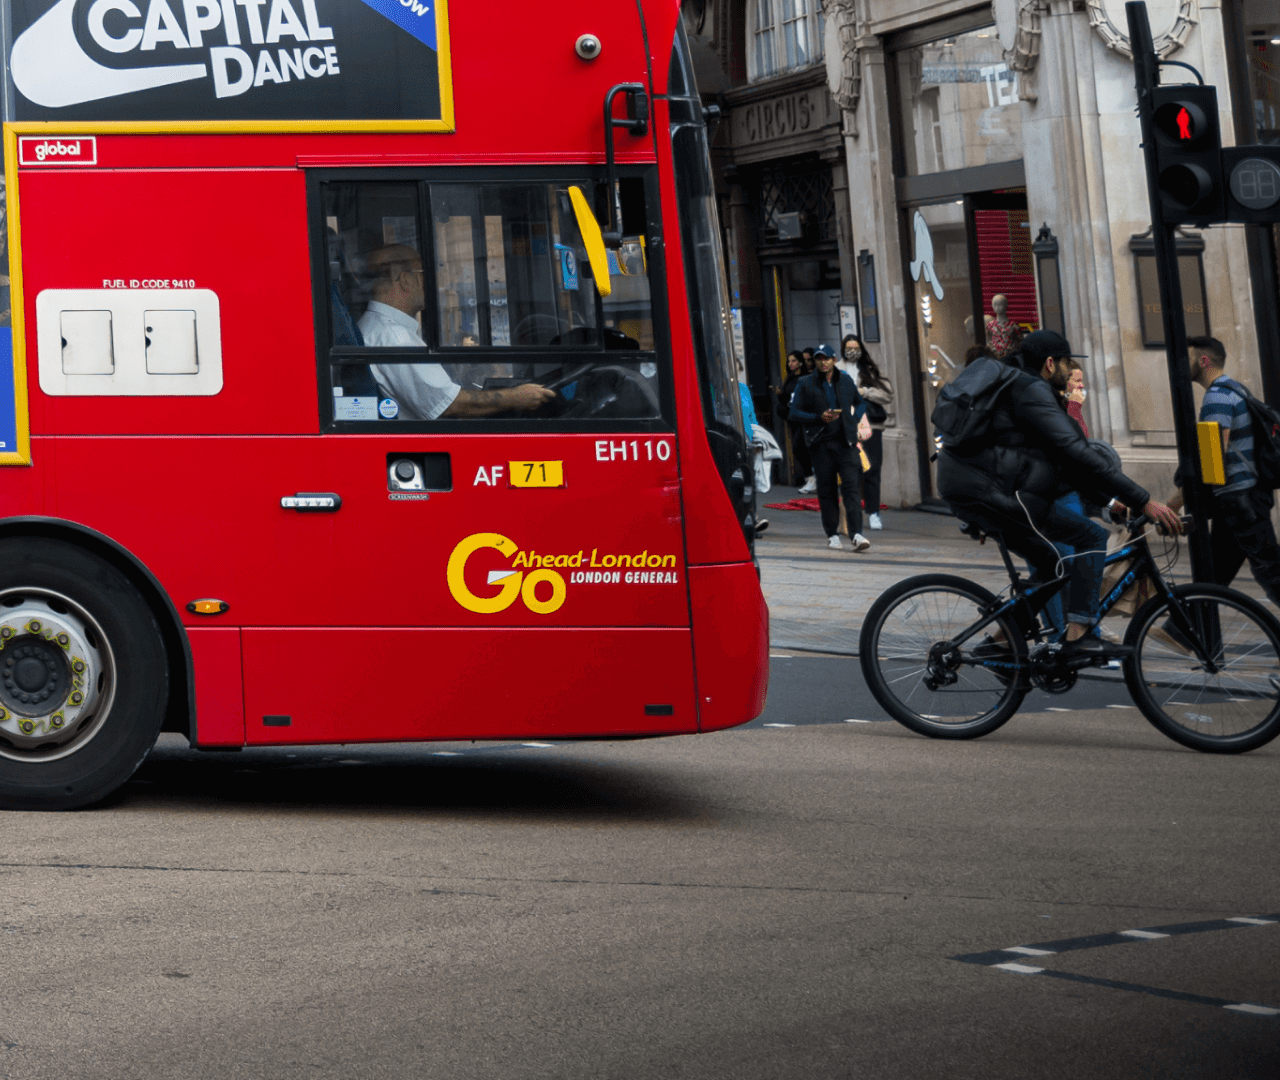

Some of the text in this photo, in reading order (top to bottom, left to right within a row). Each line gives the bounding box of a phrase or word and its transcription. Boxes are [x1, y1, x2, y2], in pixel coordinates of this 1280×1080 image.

[210, 45, 340, 99] DANCE
[746, 93, 810, 141] CIRCUS
[34, 139, 81, 162] global
[103, 279, 195, 289] FUEL ID CODE 9410
[594, 439, 671, 462] EH110
[473, 463, 548, 487] AF 71
[570, 570, 678, 585] LONDON GENERAL
